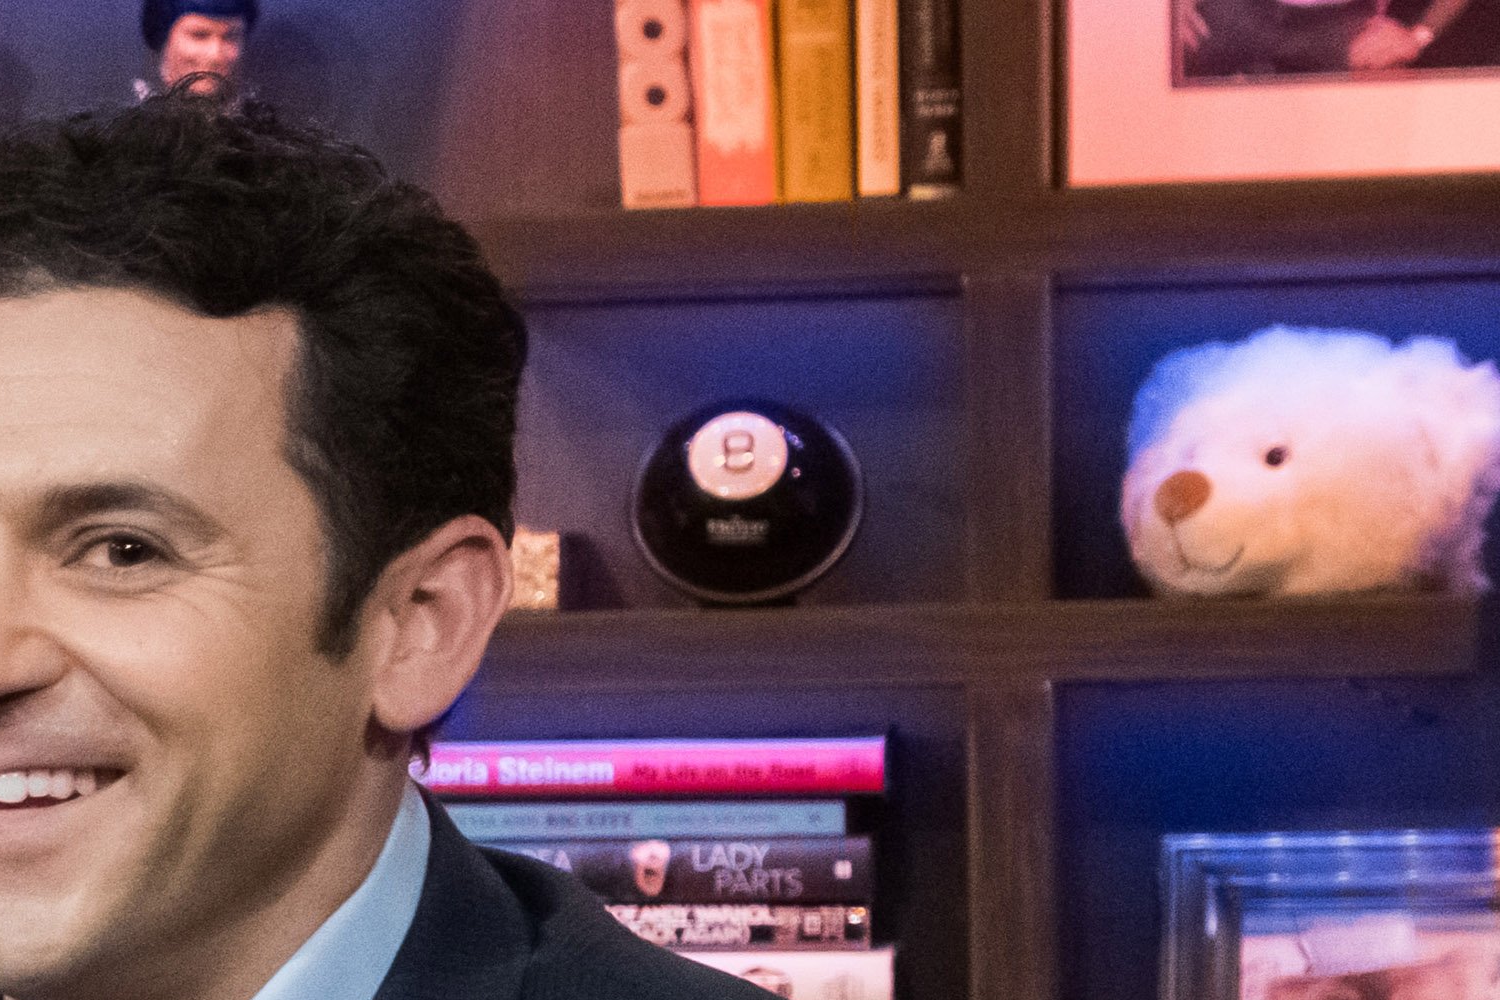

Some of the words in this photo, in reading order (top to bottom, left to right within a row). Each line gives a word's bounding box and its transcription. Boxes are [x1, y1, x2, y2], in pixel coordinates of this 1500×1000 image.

[724, 432, 756, 473] 8
[499, 755, 615, 785] Steinem
[690, 842, 770, 873] LADY
[713, 866, 803, 897] PARTS
